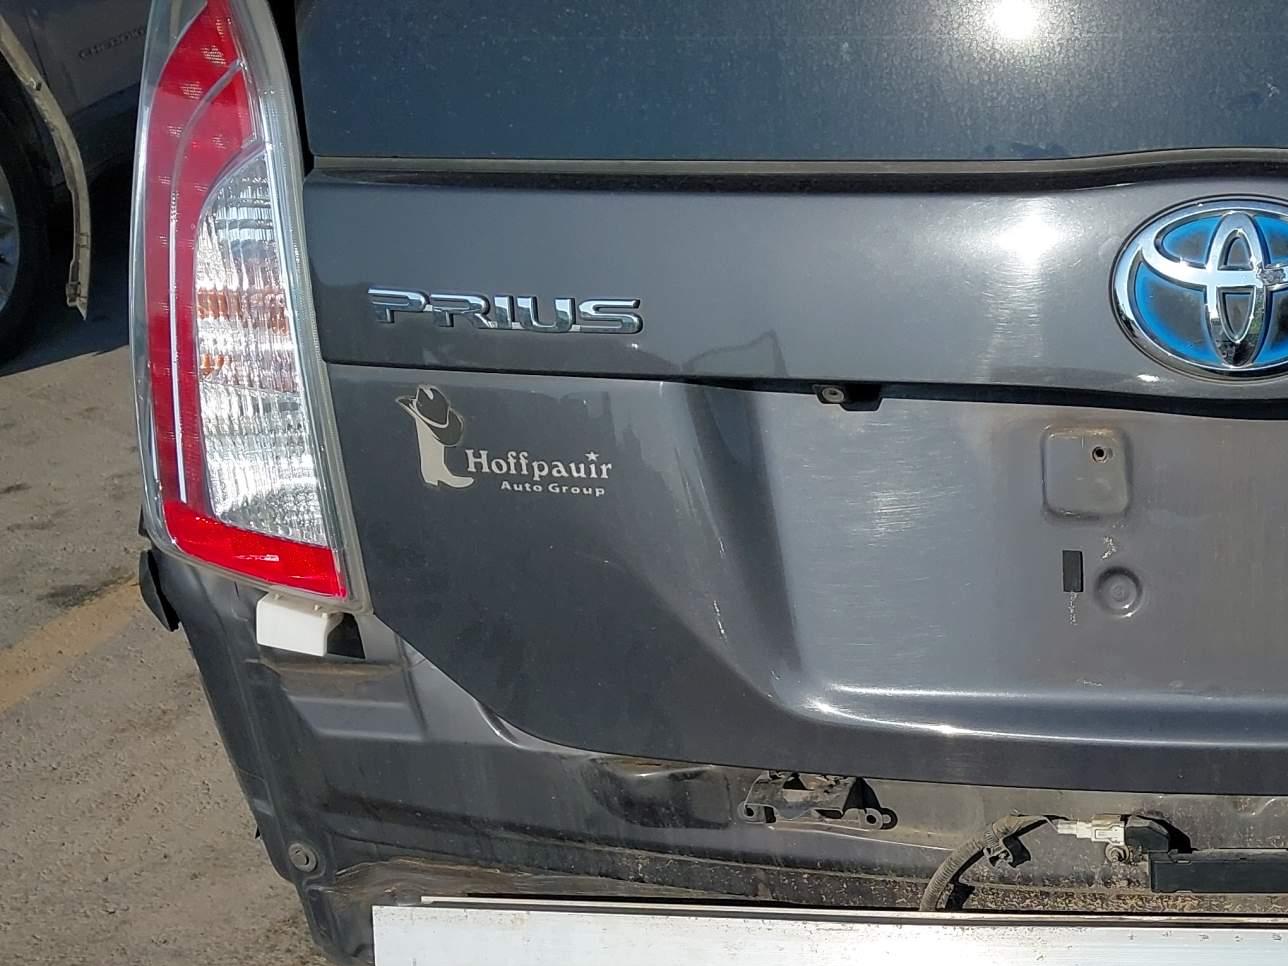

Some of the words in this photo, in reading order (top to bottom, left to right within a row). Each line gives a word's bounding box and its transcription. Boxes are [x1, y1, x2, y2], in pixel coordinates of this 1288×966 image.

[367, 287, 643, 334] PRIUS
[465, 449, 613, 481] Hoffpauir
[501, 480, 543, 493] Auto
[548, 482, 606, 497] Group
